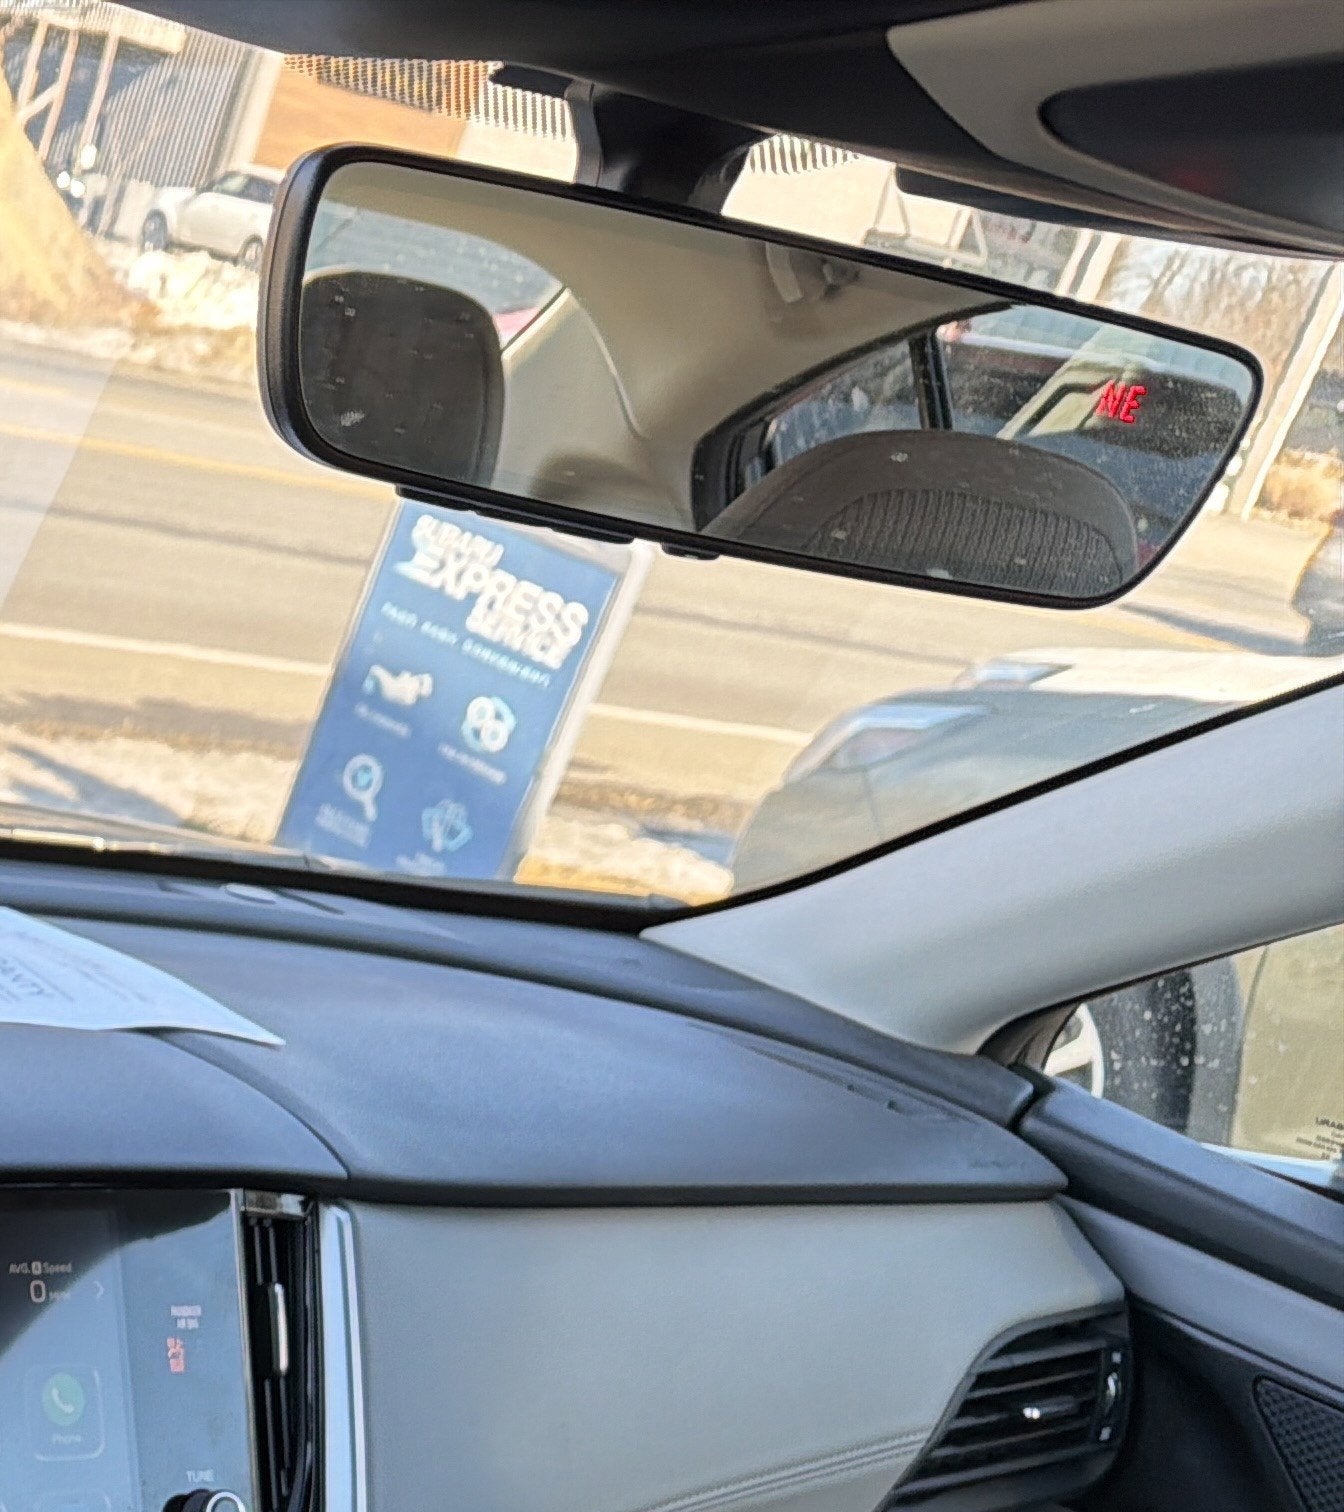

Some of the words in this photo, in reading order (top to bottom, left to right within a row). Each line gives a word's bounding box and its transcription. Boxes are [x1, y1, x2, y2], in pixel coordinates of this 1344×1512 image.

[1096, 381, 1147, 424] NE
[393, 546, 589, 644] EXPRESS
[29, 1280, 46, 1303] 0
